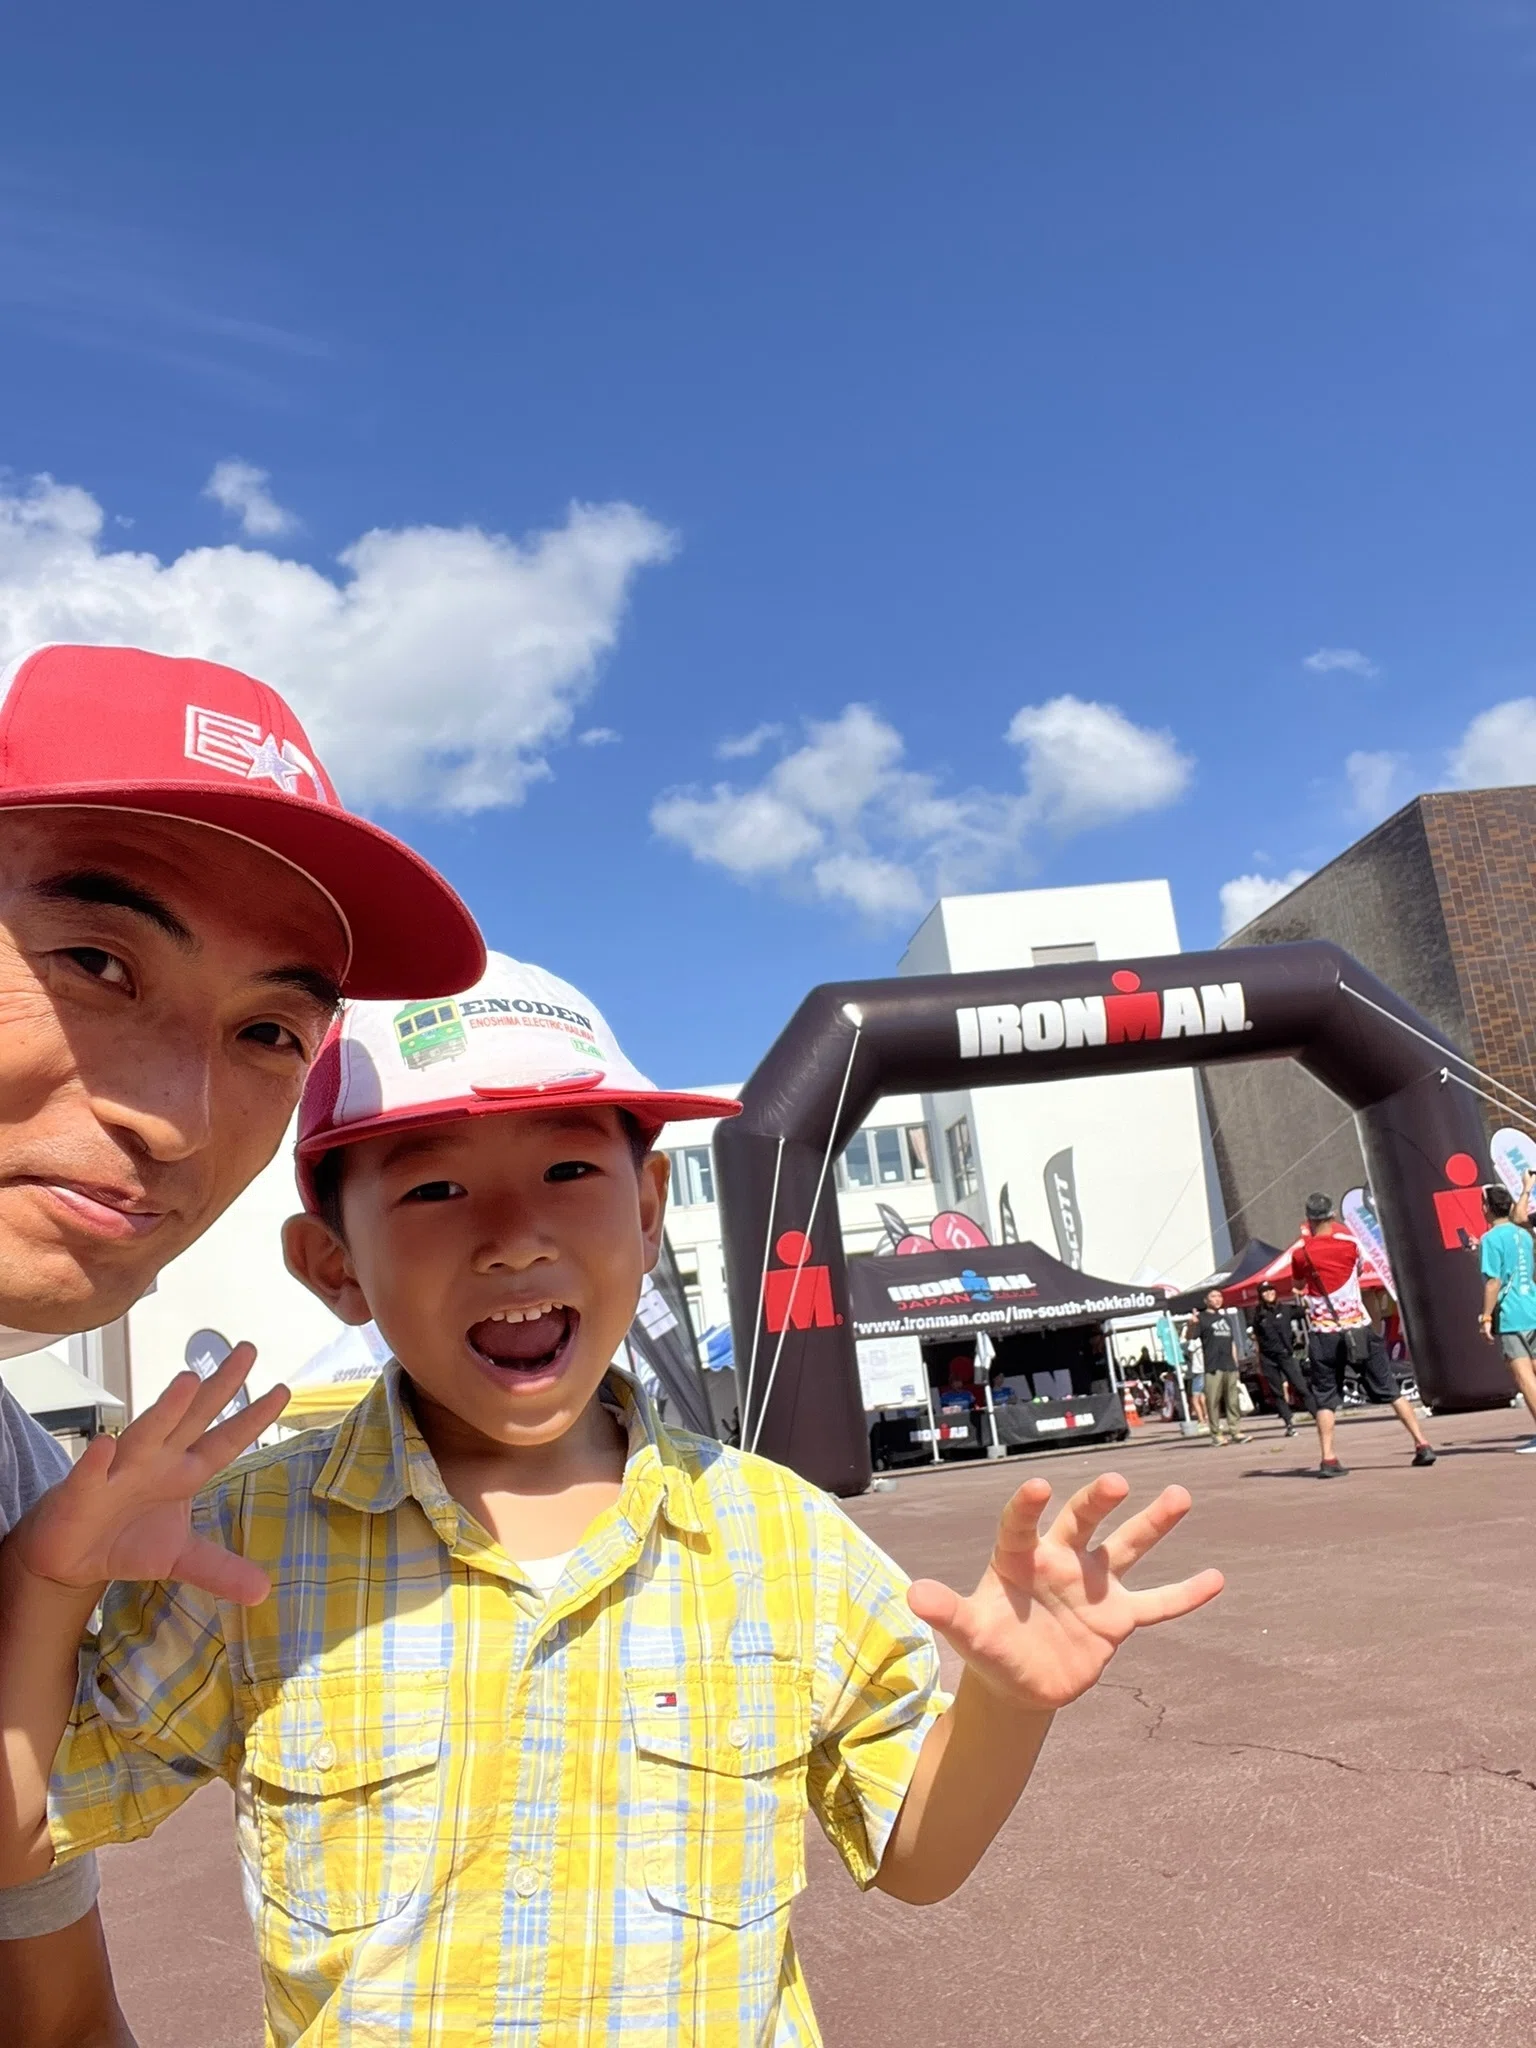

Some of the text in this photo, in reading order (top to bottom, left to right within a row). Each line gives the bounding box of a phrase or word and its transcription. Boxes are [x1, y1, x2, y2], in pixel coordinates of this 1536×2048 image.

[459, 998, 593, 1032] ENODEN
[469, 1015, 596, 1044] ENOSHIMA ELECTRIC RAILWAY
[956, 970, 1245, 1059] IRONMAN
[887, 1270, 1032, 1301] IRONMAN
[898, 1293, 972, 1311] JAPAN
